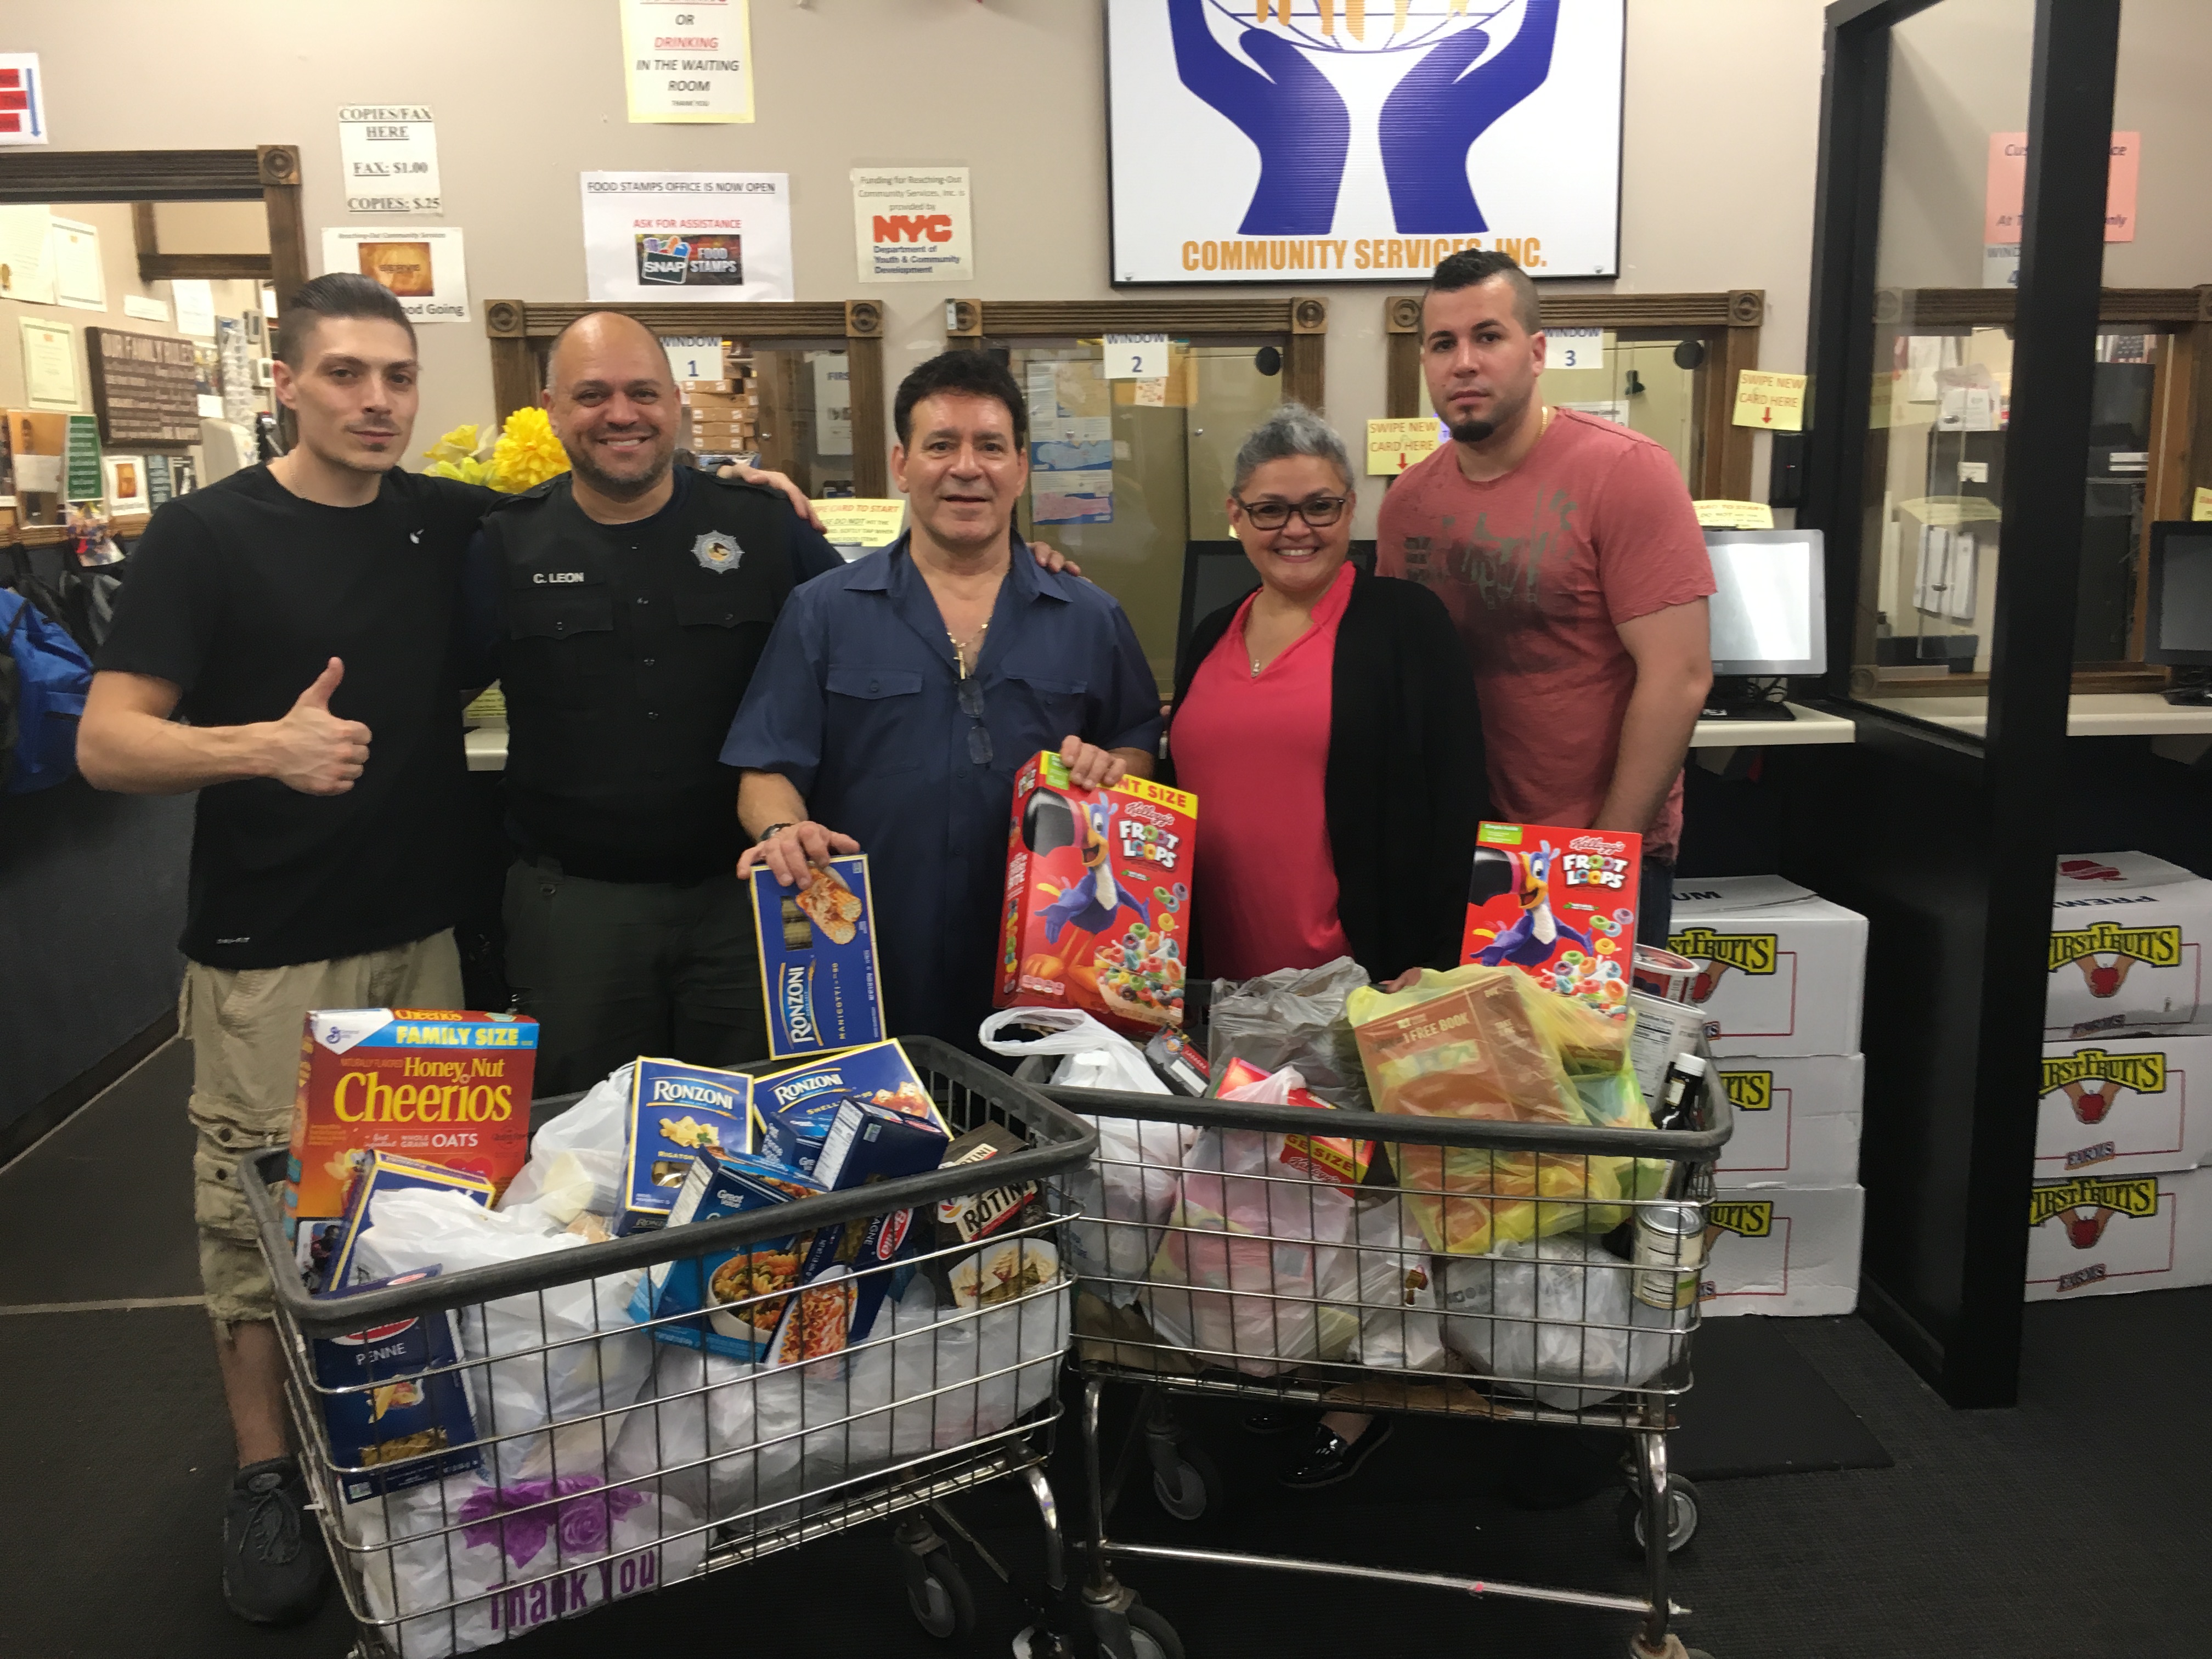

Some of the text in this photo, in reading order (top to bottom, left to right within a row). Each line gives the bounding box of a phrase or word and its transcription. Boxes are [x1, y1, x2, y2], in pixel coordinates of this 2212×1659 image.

[675, 14, 695, 25] OR
[654, 37, 719, 50] DRINKING
[636, 59, 740, 71] IN THE WAITING
[668, 81, 710, 92] ROOM
[366, 126, 409, 140] HERE
[586, 182, 775, 193] FOOD STAMPS OFFICE IS NOW OPEN
[860, 177, 892, 185] Funding
[633, 219, 742, 228] ASK FOR ASSISTANCE
[873, 215, 952, 242] NYC
[698, 247, 728, 259] FOOD
[1182, 240, 1348, 271] COMMUNITY
[644, 261, 686, 273] SNAP
[690, 261, 737, 273] STAMPS
[426, 303, 464, 317] Going
[1106, 334, 1166, 345] WINDOW
[1131, 356, 1143, 373] 2
[1565, 350, 1577, 366] 3
[687, 360, 699, 377] 1
[827, 372, 850, 380] FIRS
[1741, 374, 1805, 390] SWIPE NEW
[1739, 393, 1798, 408] CARD HERE
[1369, 422, 1438, 433] SWIPE NEW
[1371, 441, 1434, 452] CARD HERE
[533, 572, 585, 584] C. LEON
[1148, 785, 1187, 808] SIZE
[1125, 802, 1175, 827] Kellogg's
[1119, 820, 1179, 849] FROOT
[1123, 839, 1177, 868] LOOPS
[1568, 836, 1626, 855] Kellogg's
[1563, 854, 1628, 872] FROOT
[1566, 870, 1625, 888] LOOPS
[788, 966, 815, 1043] RONZONI
[834, 985, 845, 1040] MANICOTTI
[1409, 1023, 1440, 1041] FREE
[1438, 1012, 1470, 1032] BOOK
[396, 1026, 519, 1046] FAMILY SIZE
[404, 1057, 505, 1083] Honey Nut
[334, 1071, 512, 1122] Cheerios
[653, 1080, 733, 1109] RONZONI
[773, 1074, 844, 1105] RONZONI
[432, 1133, 478, 1148] OATS
[1313, 1148, 1353, 1172] SIZE
[717, 1189, 744, 1203] Great
[356, 1343, 407, 1365] PENNE
[486, 1571, 588, 1630] Thank
